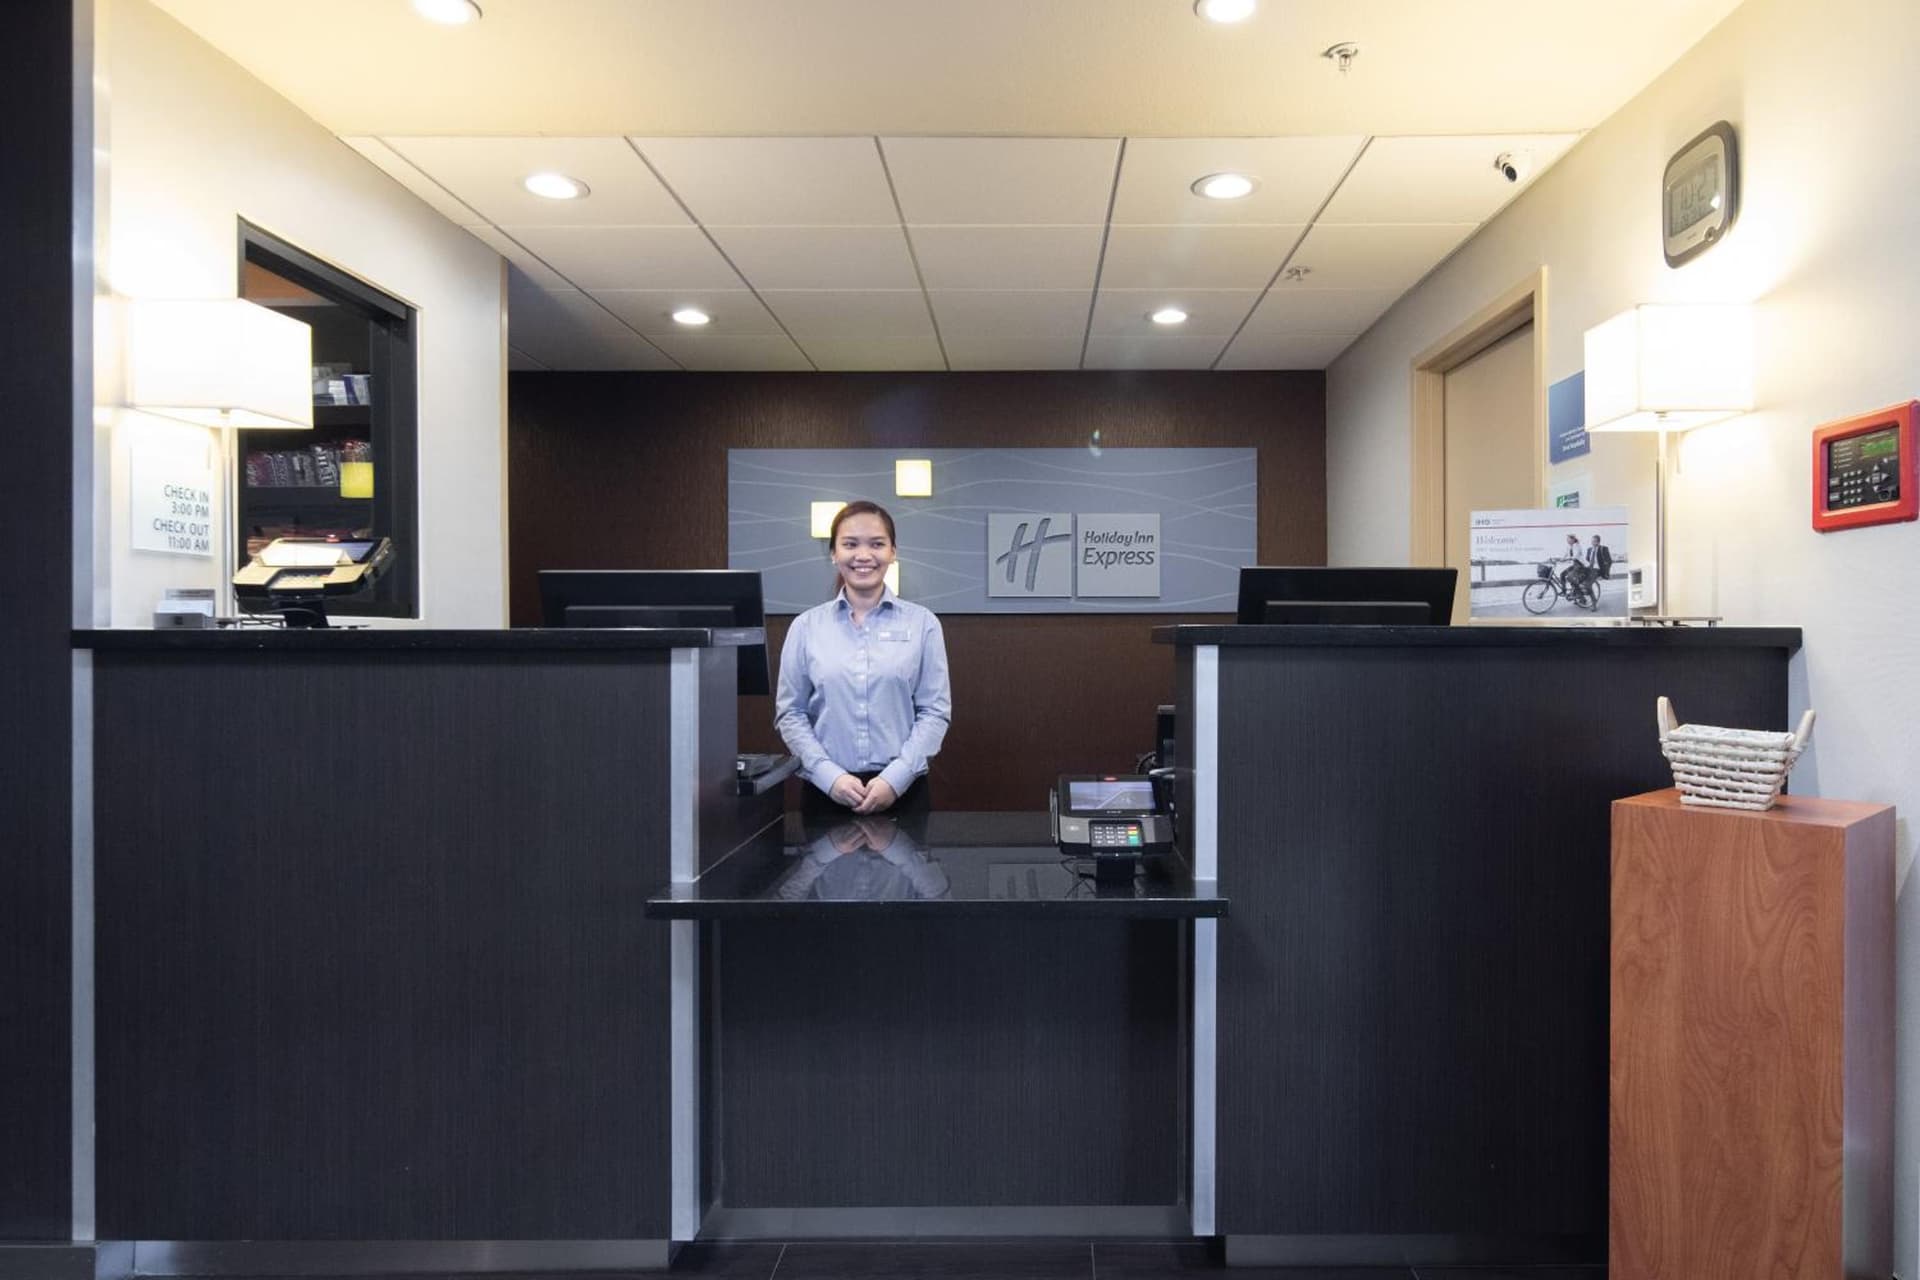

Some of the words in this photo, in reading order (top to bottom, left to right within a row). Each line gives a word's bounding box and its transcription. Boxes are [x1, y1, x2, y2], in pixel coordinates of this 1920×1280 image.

[163, 484, 197, 501] CHECK
[199, 490, 209, 503] IN
[172, 501, 193, 516] 3:00
[195, 504, 209, 518] PM
[153, 518, 186, 534] CHECK
[189, 522, 209, 537] OUT
[168, 536, 192, 550] 11:00
[194, 539, 209, 553] AM
[1084, 530, 1133, 547] Holiday
[1134, 530, 1154, 544] Inn
[1083, 547, 1155, 570] Express
